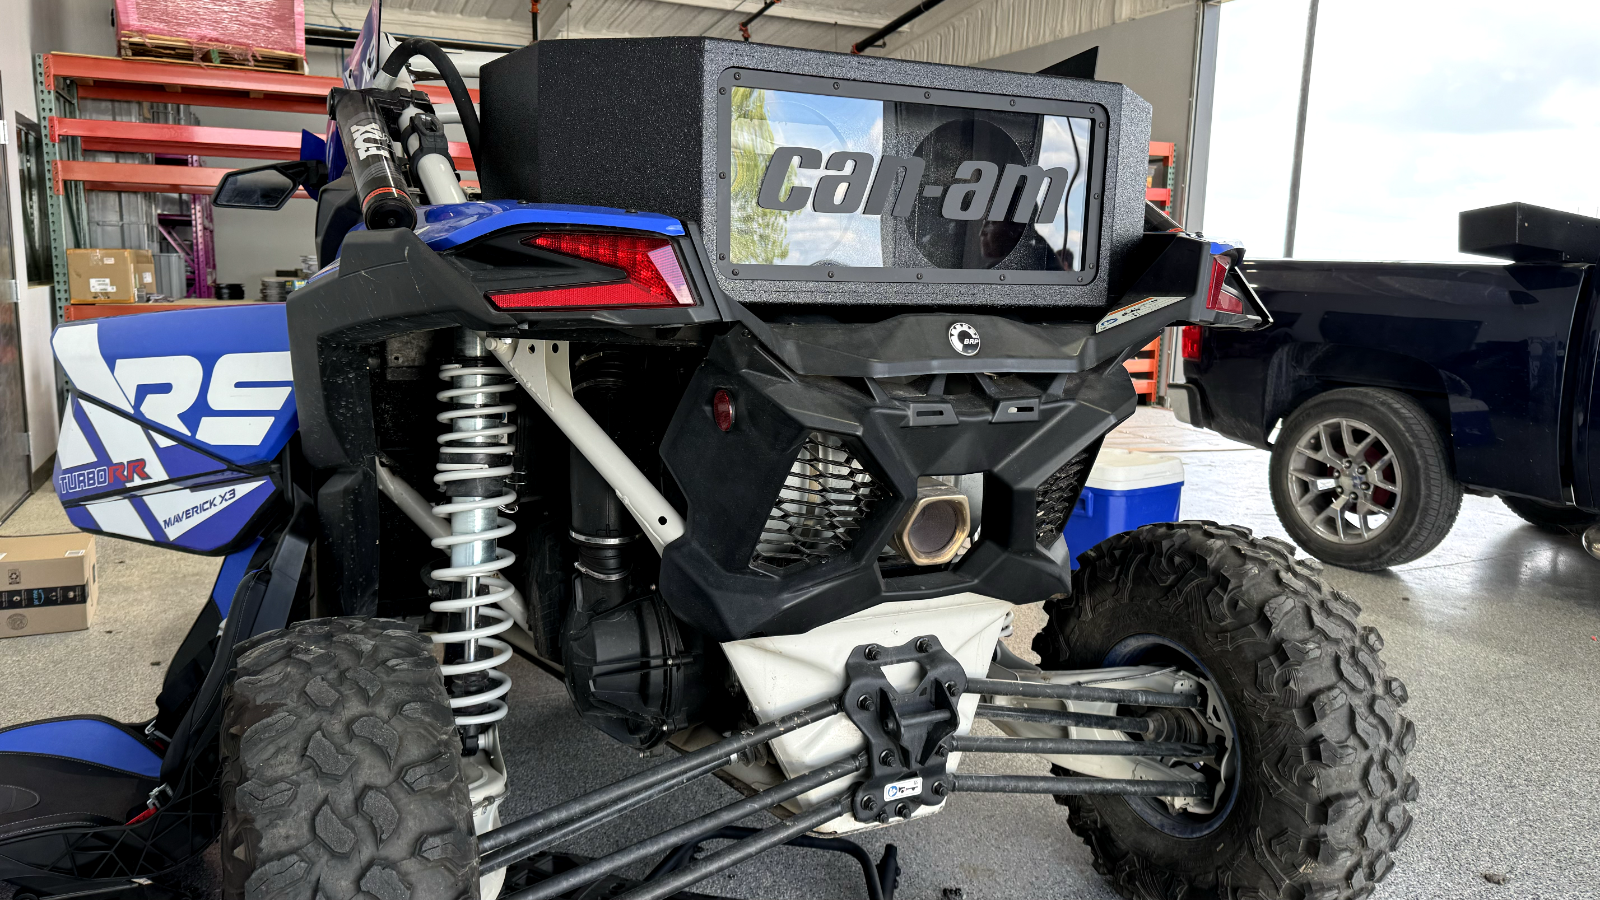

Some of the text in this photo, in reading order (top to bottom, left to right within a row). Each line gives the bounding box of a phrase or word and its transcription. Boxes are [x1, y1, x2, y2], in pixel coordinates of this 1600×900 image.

[350, 123, 391, 161] FOX
[757, 146, 1069, 224] can-am
[162, 488, 236, 529] MAVERICK X3
